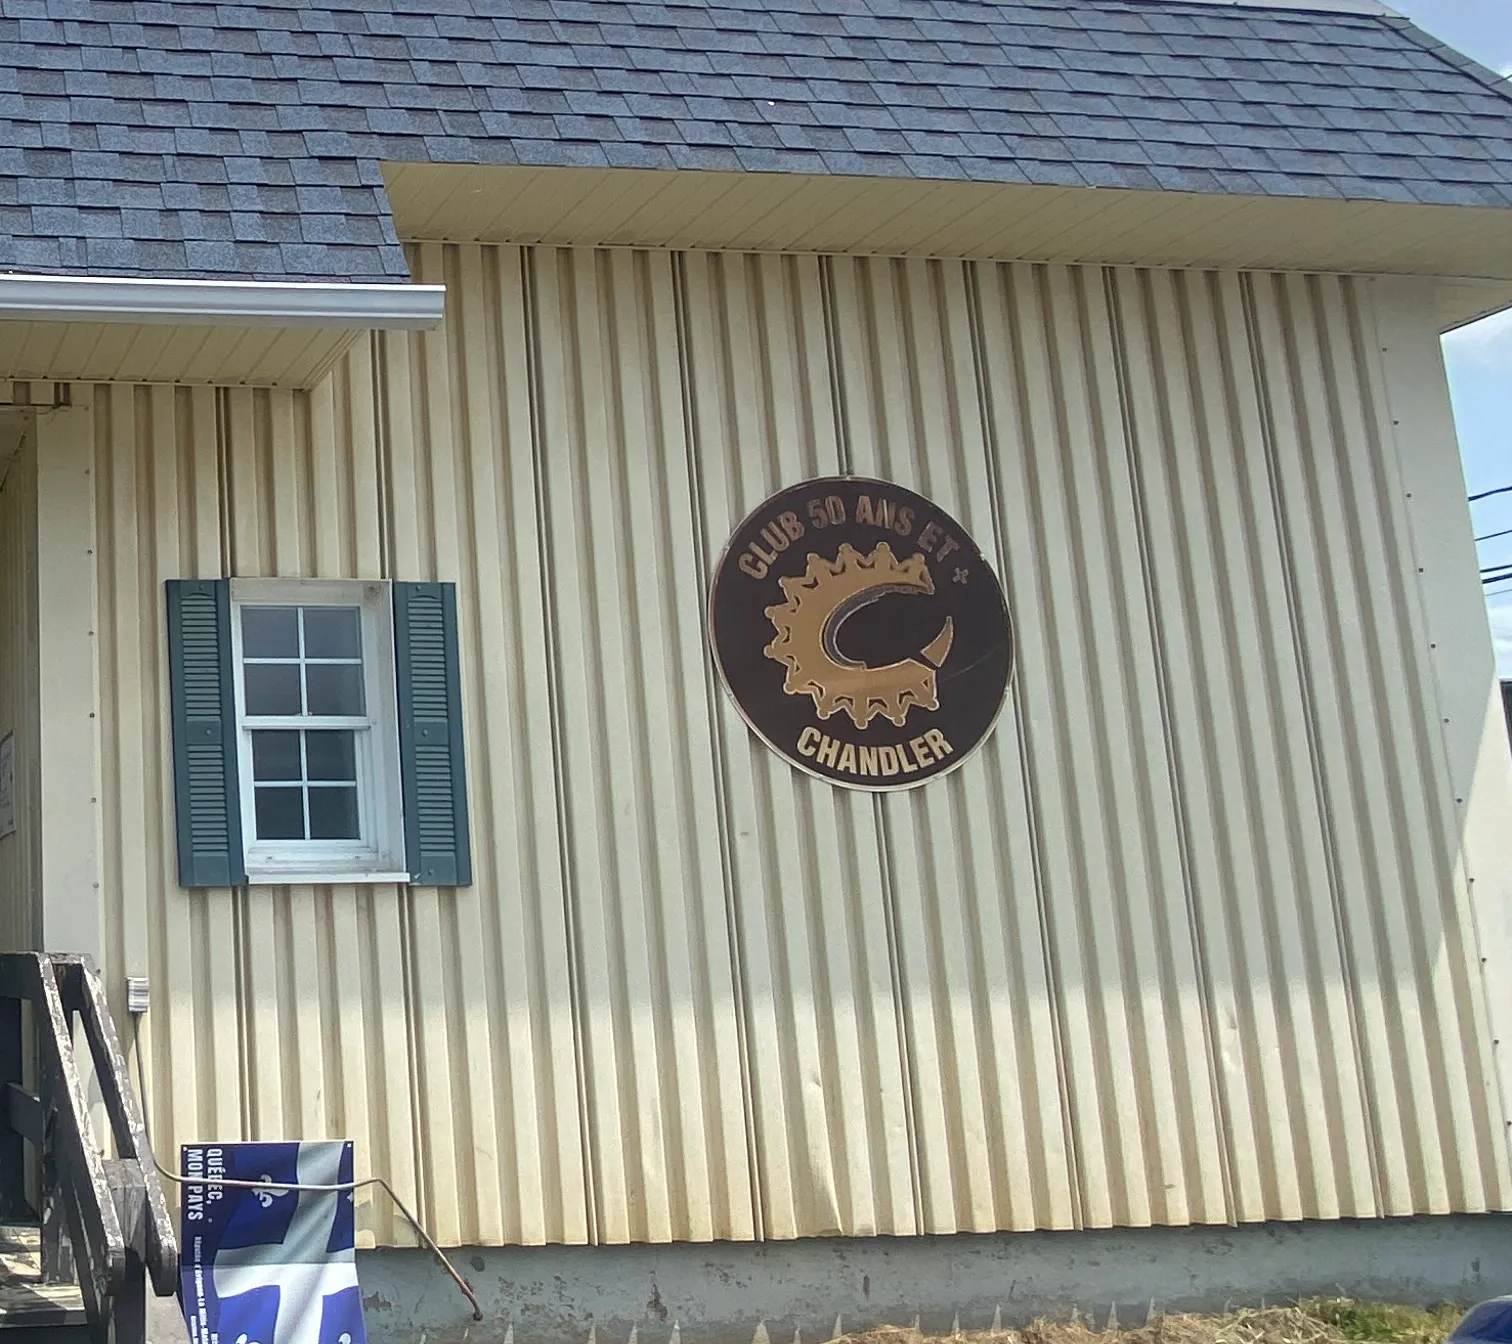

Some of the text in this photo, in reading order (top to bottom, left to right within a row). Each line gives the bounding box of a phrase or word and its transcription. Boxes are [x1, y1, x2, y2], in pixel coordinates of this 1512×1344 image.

[739, 511, 805, 580] CLUB
[807, 495, 846, 529] 50
[855, 495, 915, 536] ANS
[917, 521, 960, 562] ET
[796, 726, 954, 776] CHANDLER
[187, 1185, 204, 1221] PAYS
